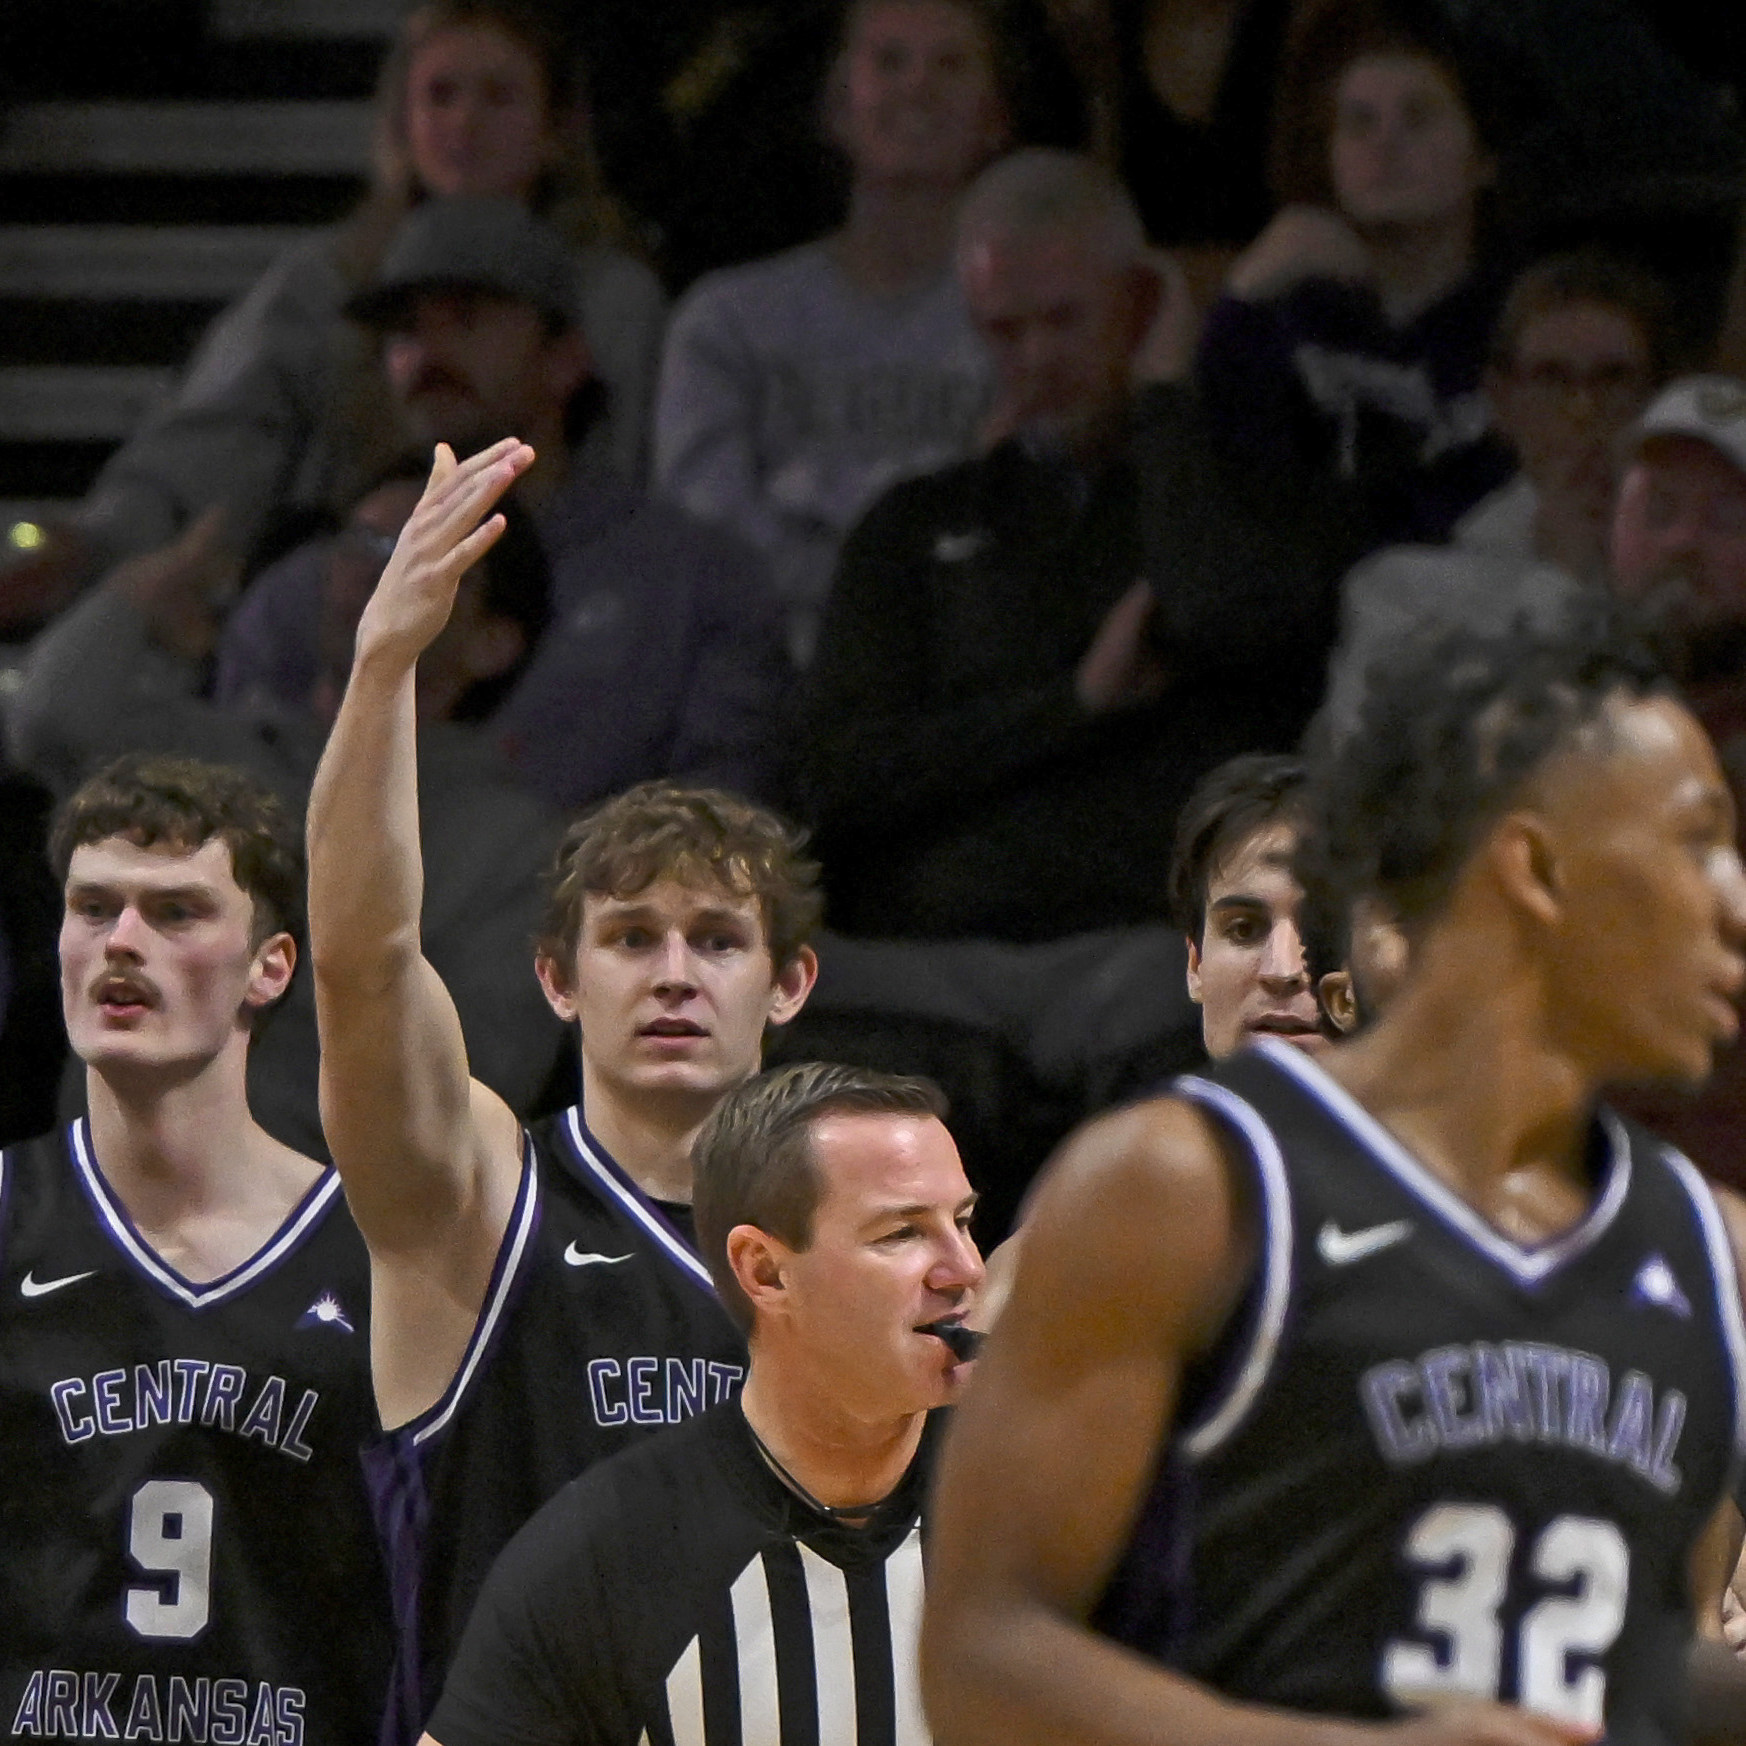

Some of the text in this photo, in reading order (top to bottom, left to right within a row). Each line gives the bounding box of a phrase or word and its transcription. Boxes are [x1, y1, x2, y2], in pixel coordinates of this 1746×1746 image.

[50, 1358, 319, 1461] CENTRAL
[1357, 1338, 1688, 1495] CENTRAL
[125, 1479, 214, 1639] 9
[1379, 1500, 1630, 1738] 32
